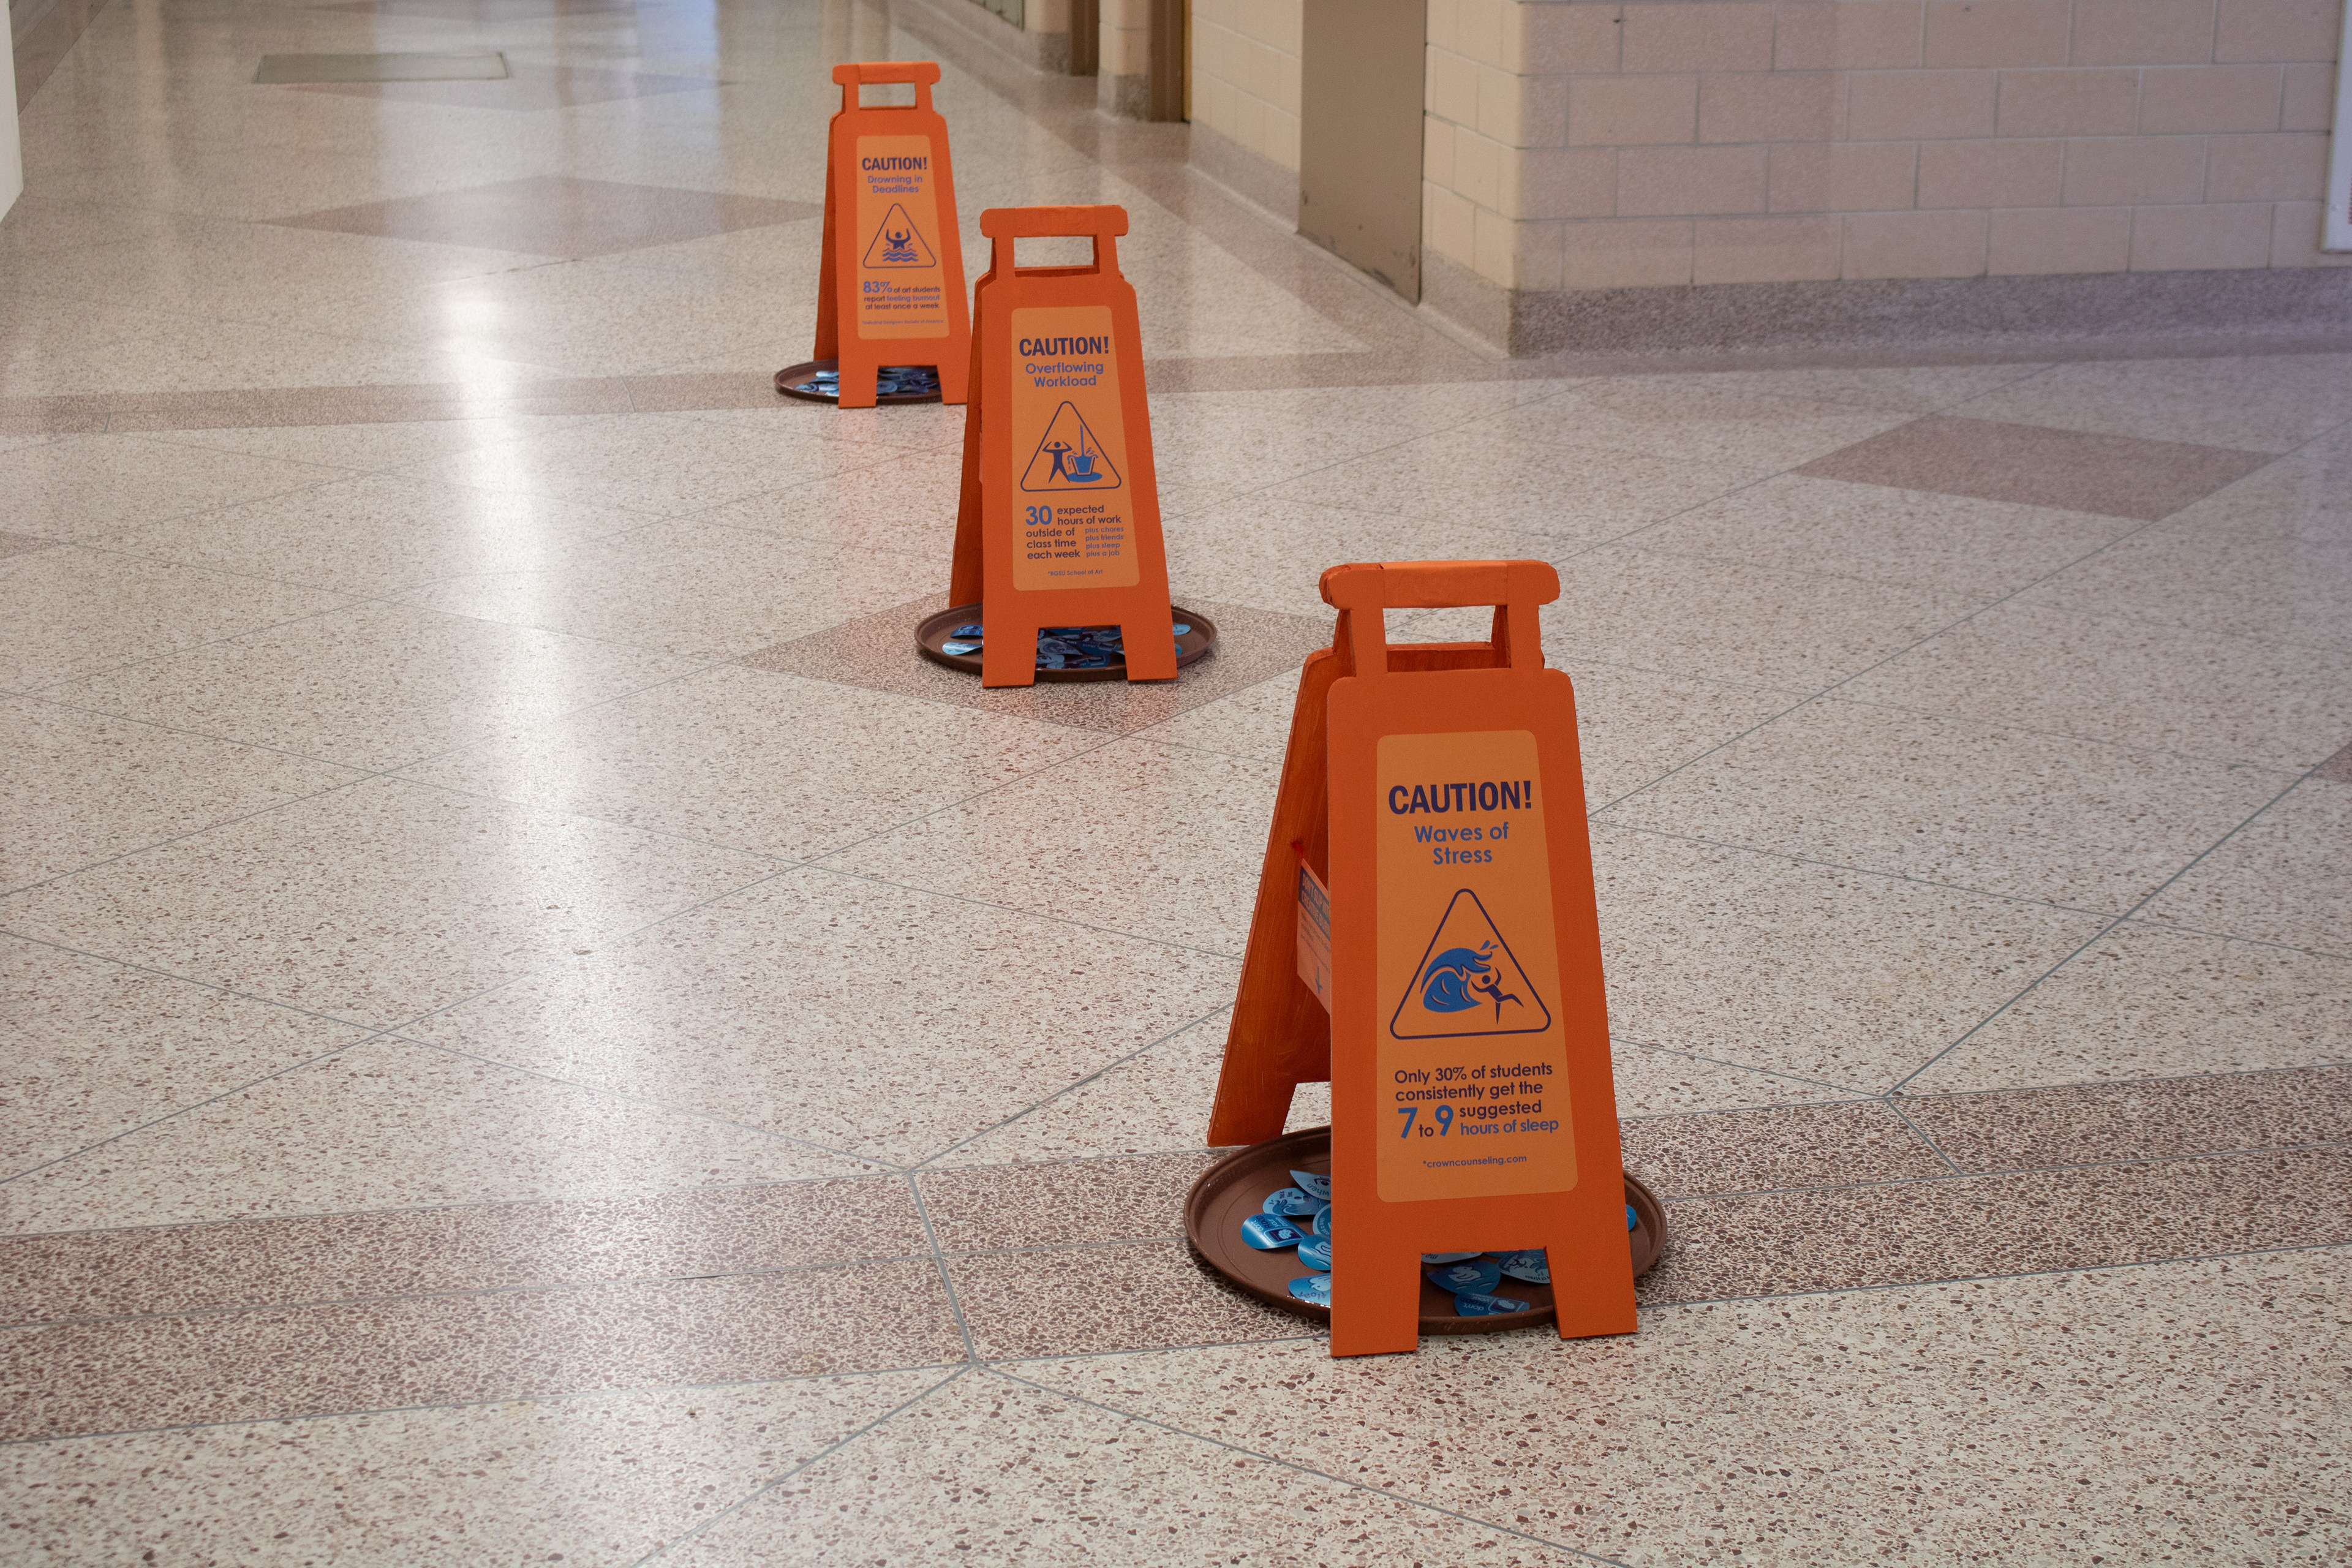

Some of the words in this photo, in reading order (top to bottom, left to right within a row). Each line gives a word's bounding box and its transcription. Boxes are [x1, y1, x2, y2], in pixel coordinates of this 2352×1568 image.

[862, 157, 927, 170] CAUTION!
[868, 175, 911, 184] Drowning
[864, 281, 892, 293] 83%
[1020, 337, 1109, 356] CAUTION!
[1026, 361, 1103, 374] Overflowing
[1034, 375, 1096, 387] Workload
[1026, 506, 1052, 526] 30
[1057, 505, 1104, 516] expected
[1026, 529, 1062, 537] outside
[1066, 527, 1074, 536] of
[1028, 551, 1052, 559] each
[1055, 549, 1080, 558] week
[1389, 781, 1531, 814] CAUTION!
[1414, 826, 1482, 842] Waves
[1490, 822, 1508, 839] of
[1433, 847, 1492, 865] Stress
[1395, 1069, 1430, 1085] Only
[1436, 1066, 1466, 1081] 30%
[1472, 1065, 1485, 1079] of
[1490, 1063, 1552, 1078] students
[1396, 1085, 1485, 1101] consistently
[1490, 1083, 1515, 1099] get
[1519, 1081, 1543, 1094] the
[1460, 1100, 1541, 1121] suggested
[1398, 1107, 1417, 1139] 7
[1419, 1124, 1434, 1137] to
[1435, 1105, 1453, 1136] 9
[1461, 1119, 1499, 1135] hours
[1503, 1119, 1517, 1133] of
[1520, 1119, 1559, 1134] sleep
